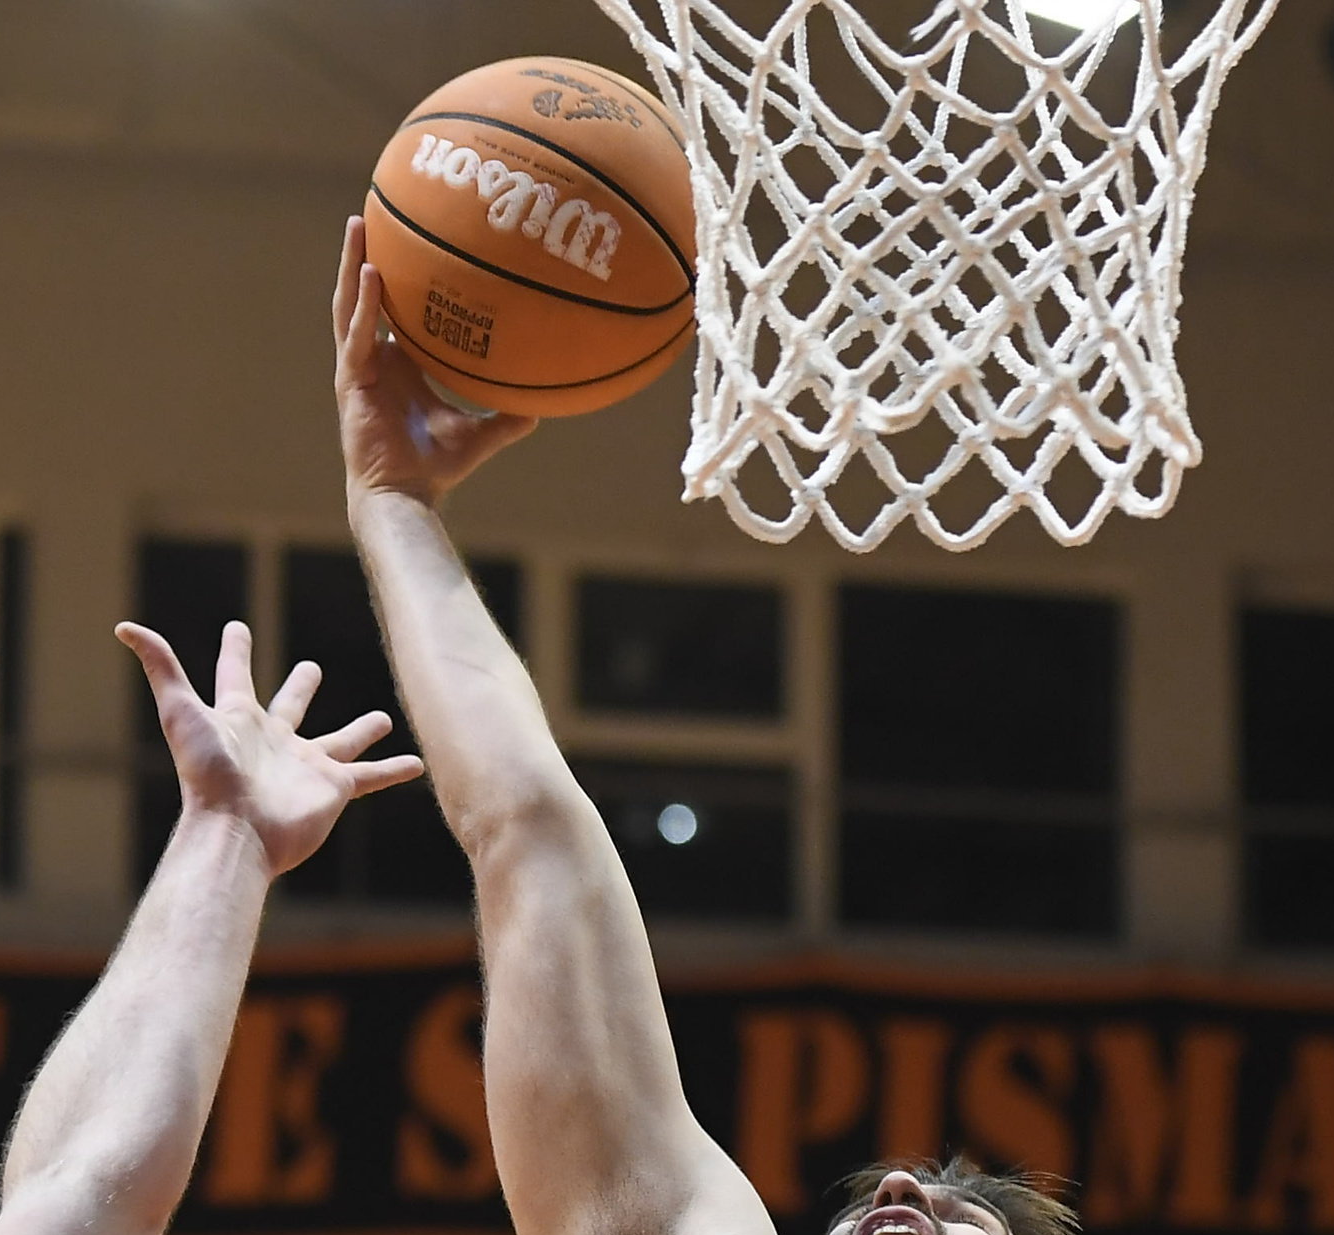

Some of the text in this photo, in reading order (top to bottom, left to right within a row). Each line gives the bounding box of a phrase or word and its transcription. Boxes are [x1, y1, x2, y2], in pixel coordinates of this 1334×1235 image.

[412, 133, 621, 282] Wilson
[424, 304, 490, 359] FIBA
[428, 290, 494, 331] APPROVED
[204, 1000, 346, 1204] E
[395, 985, 501, 1195] S
